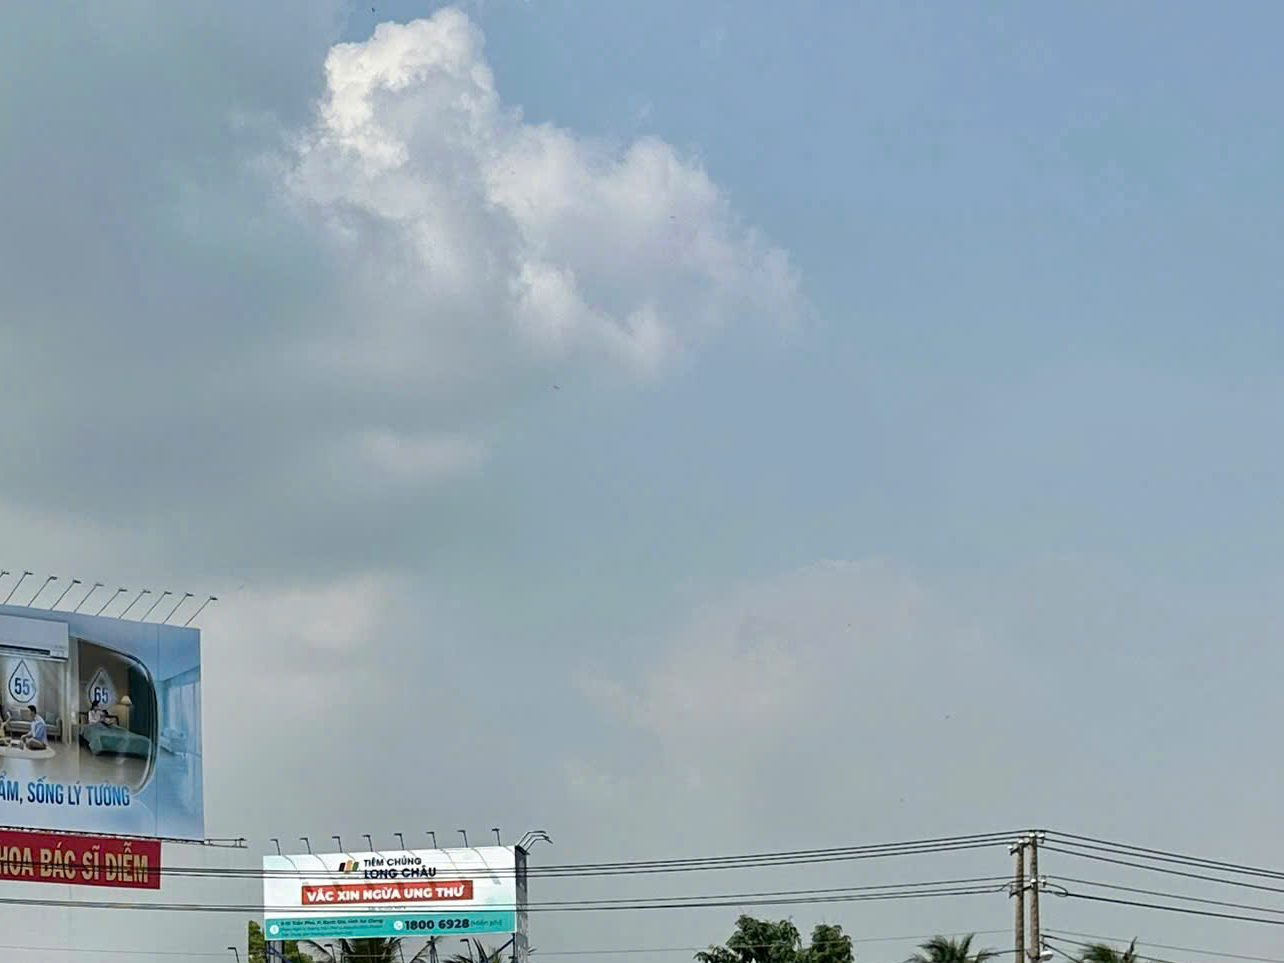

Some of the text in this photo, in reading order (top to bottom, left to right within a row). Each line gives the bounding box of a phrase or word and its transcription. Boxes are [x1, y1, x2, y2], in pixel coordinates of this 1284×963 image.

[27, 776, 64, 805] SỐNG
[68, 781, 81, 806] LÝ
[40, 841, 76, 880] BÁC
[81, 845, 100, 881] SĨ
[105, 841, 149, 884] DIỄM
[364, 856, 422, 867] TIÊM CHỦNG
[364, 865, 437, 879] LONG CHÂU
[307, 884, 465, 902] VẮC XIN NGỪA UNG THƯ
[405, 920, 435, 930] 1800
[438, 919, 470, 929] 6928
